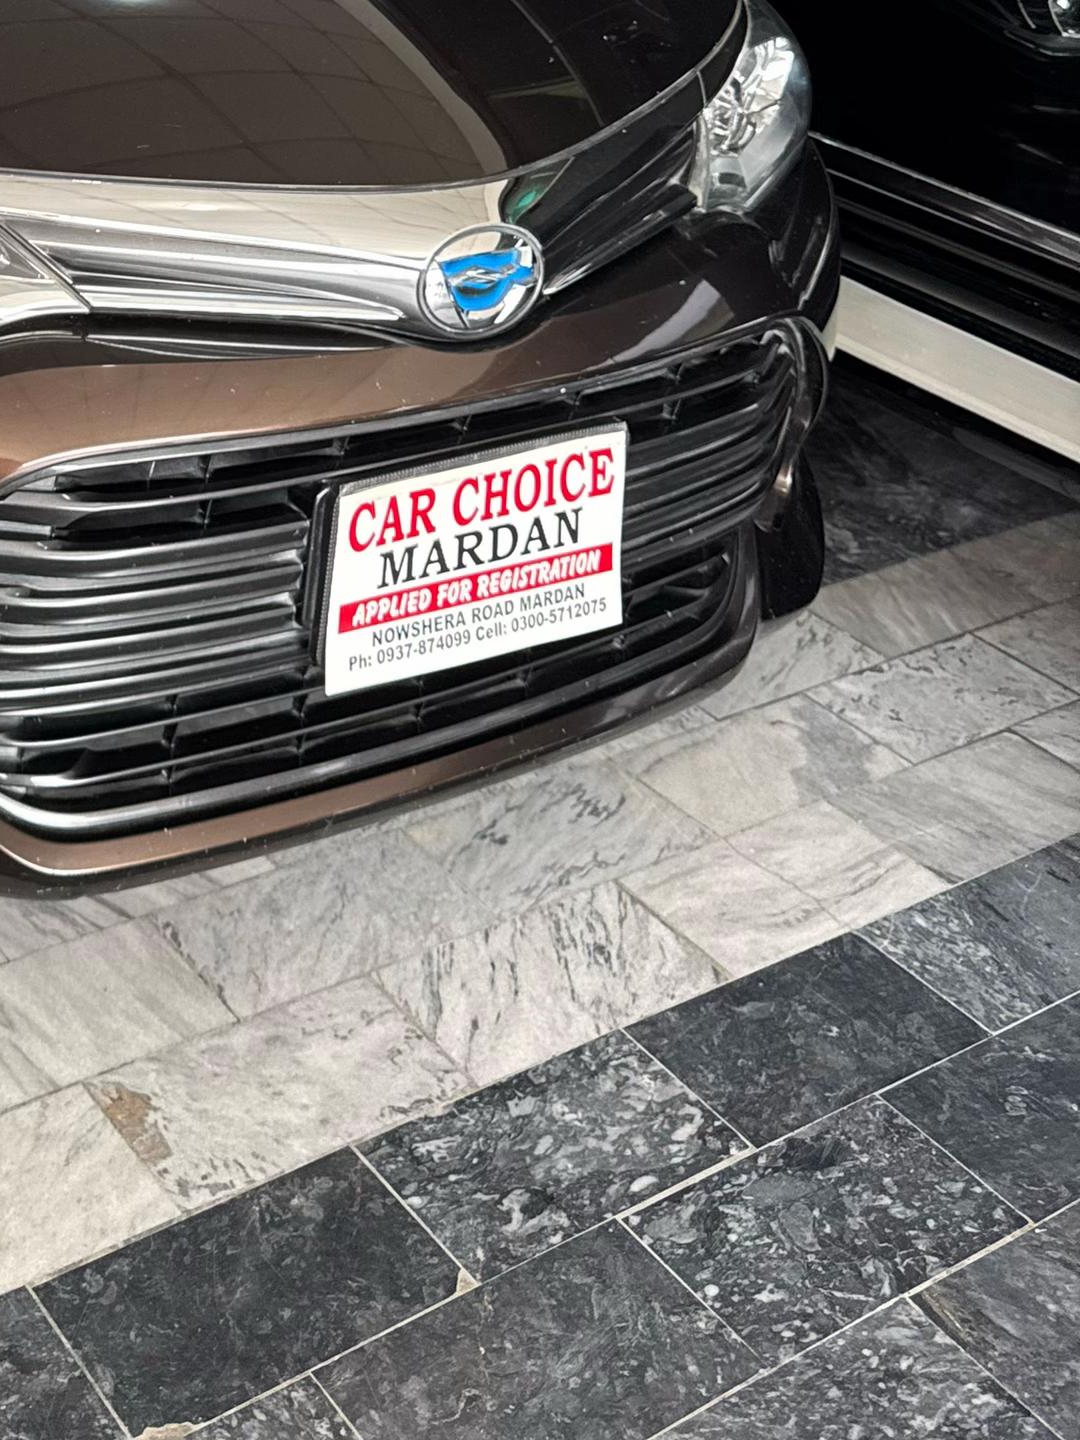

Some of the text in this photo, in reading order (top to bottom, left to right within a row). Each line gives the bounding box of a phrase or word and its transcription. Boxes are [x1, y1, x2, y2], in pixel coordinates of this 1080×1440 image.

[348, 447, 615, 552] CAR CHOICE
[377, 507, 583, 589] MARDAN
[351, 549, 601, 628] APPLIED FOR REGISTRATION
[371, 583, 585, 647] NOWSHERA ROAD MARDAN
[348, 597, 607, 671] Ph: 0937-874099 Cell: 0300-5712075
